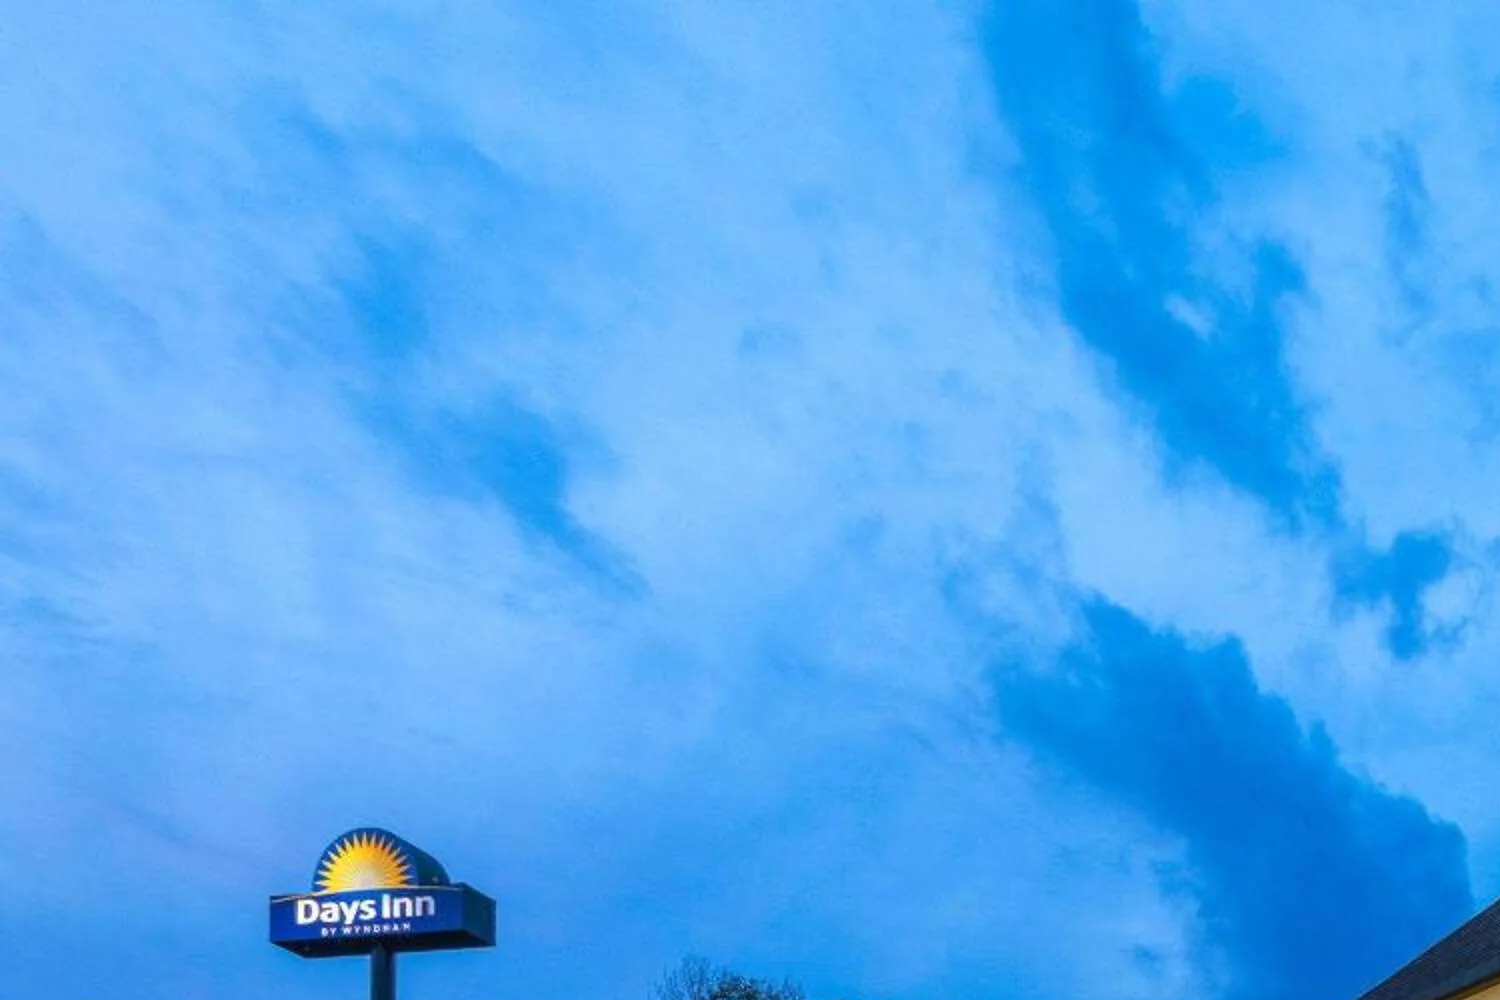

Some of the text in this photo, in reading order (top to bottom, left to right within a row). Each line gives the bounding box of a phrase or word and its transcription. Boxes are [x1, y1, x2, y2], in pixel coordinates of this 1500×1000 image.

[294, 893, 436, 926] Days Inn
[320, 922, 412, 938] BY WYNDHAM
